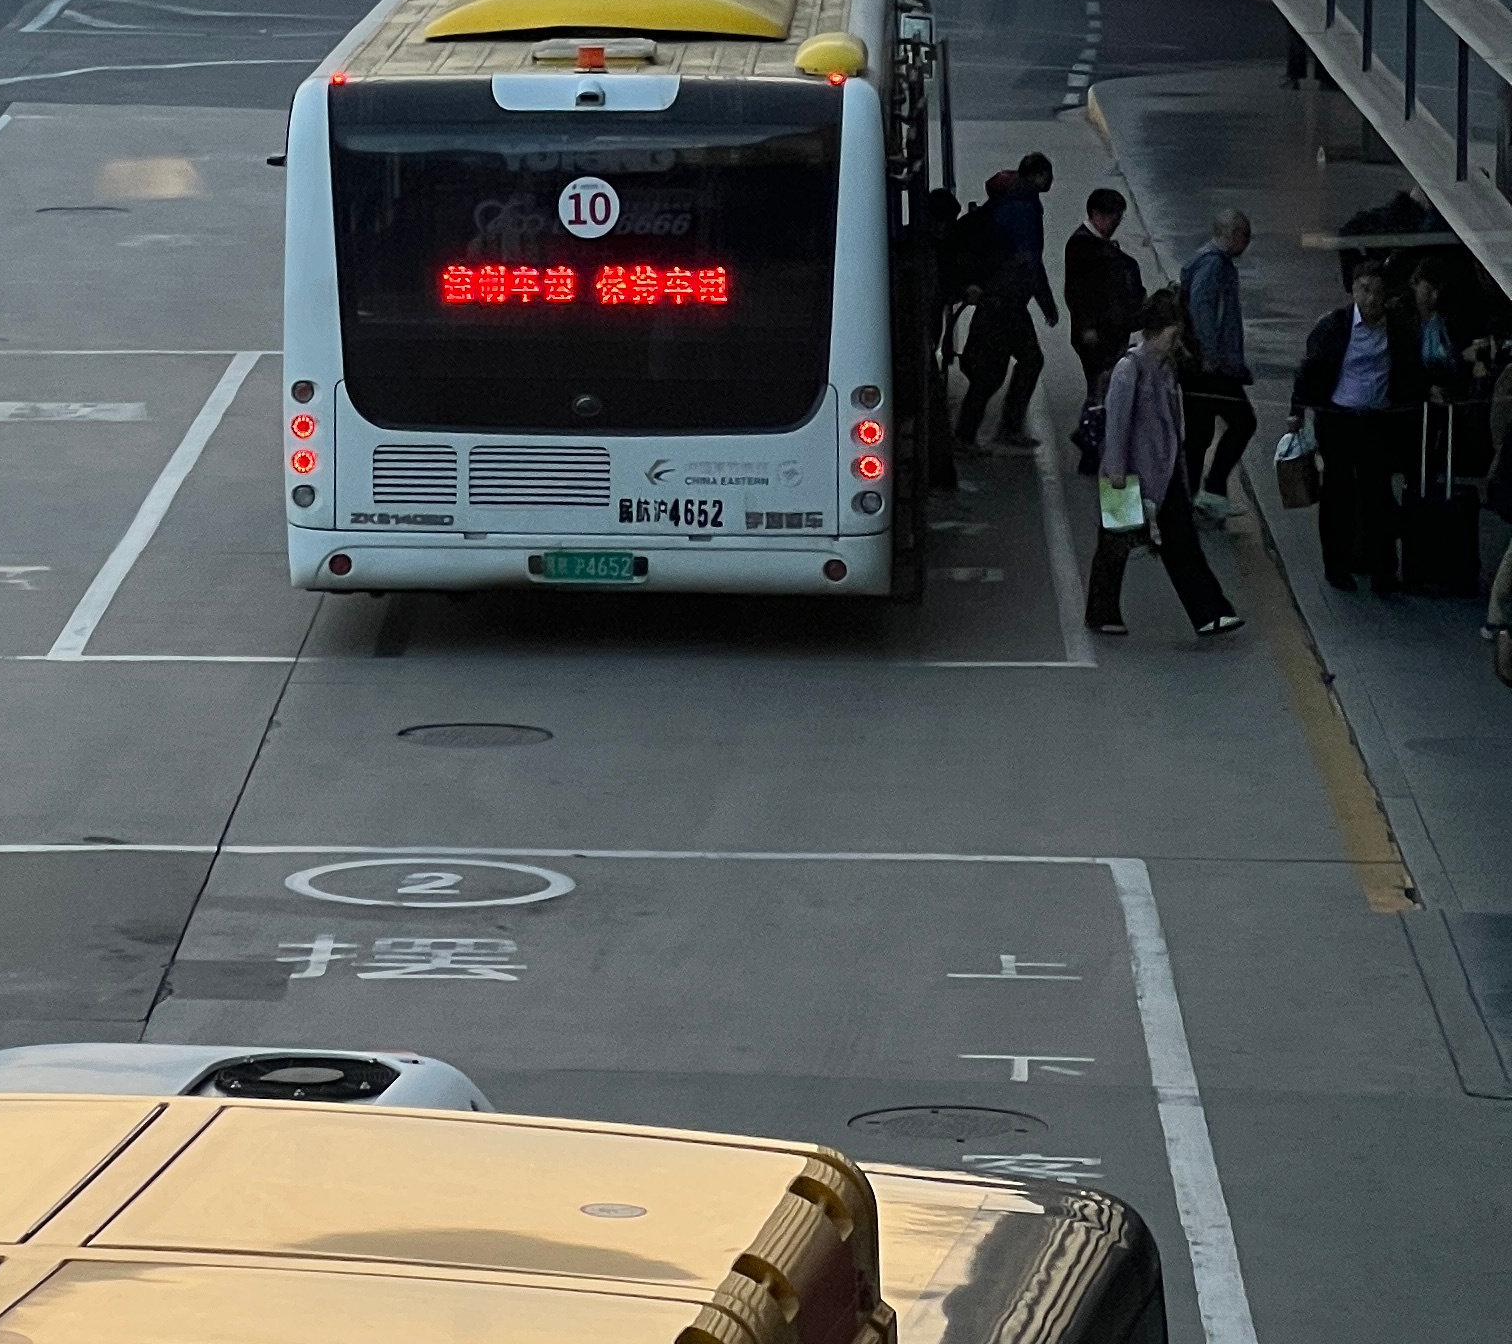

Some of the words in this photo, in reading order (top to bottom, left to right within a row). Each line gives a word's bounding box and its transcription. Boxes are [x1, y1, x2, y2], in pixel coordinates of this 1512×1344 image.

[568, 192, 611, 225] 10
[685, 476, 717, 486] CHINA
[720, 476, 769, 486] EASTERN
[397, 872, 463, 894] 2
